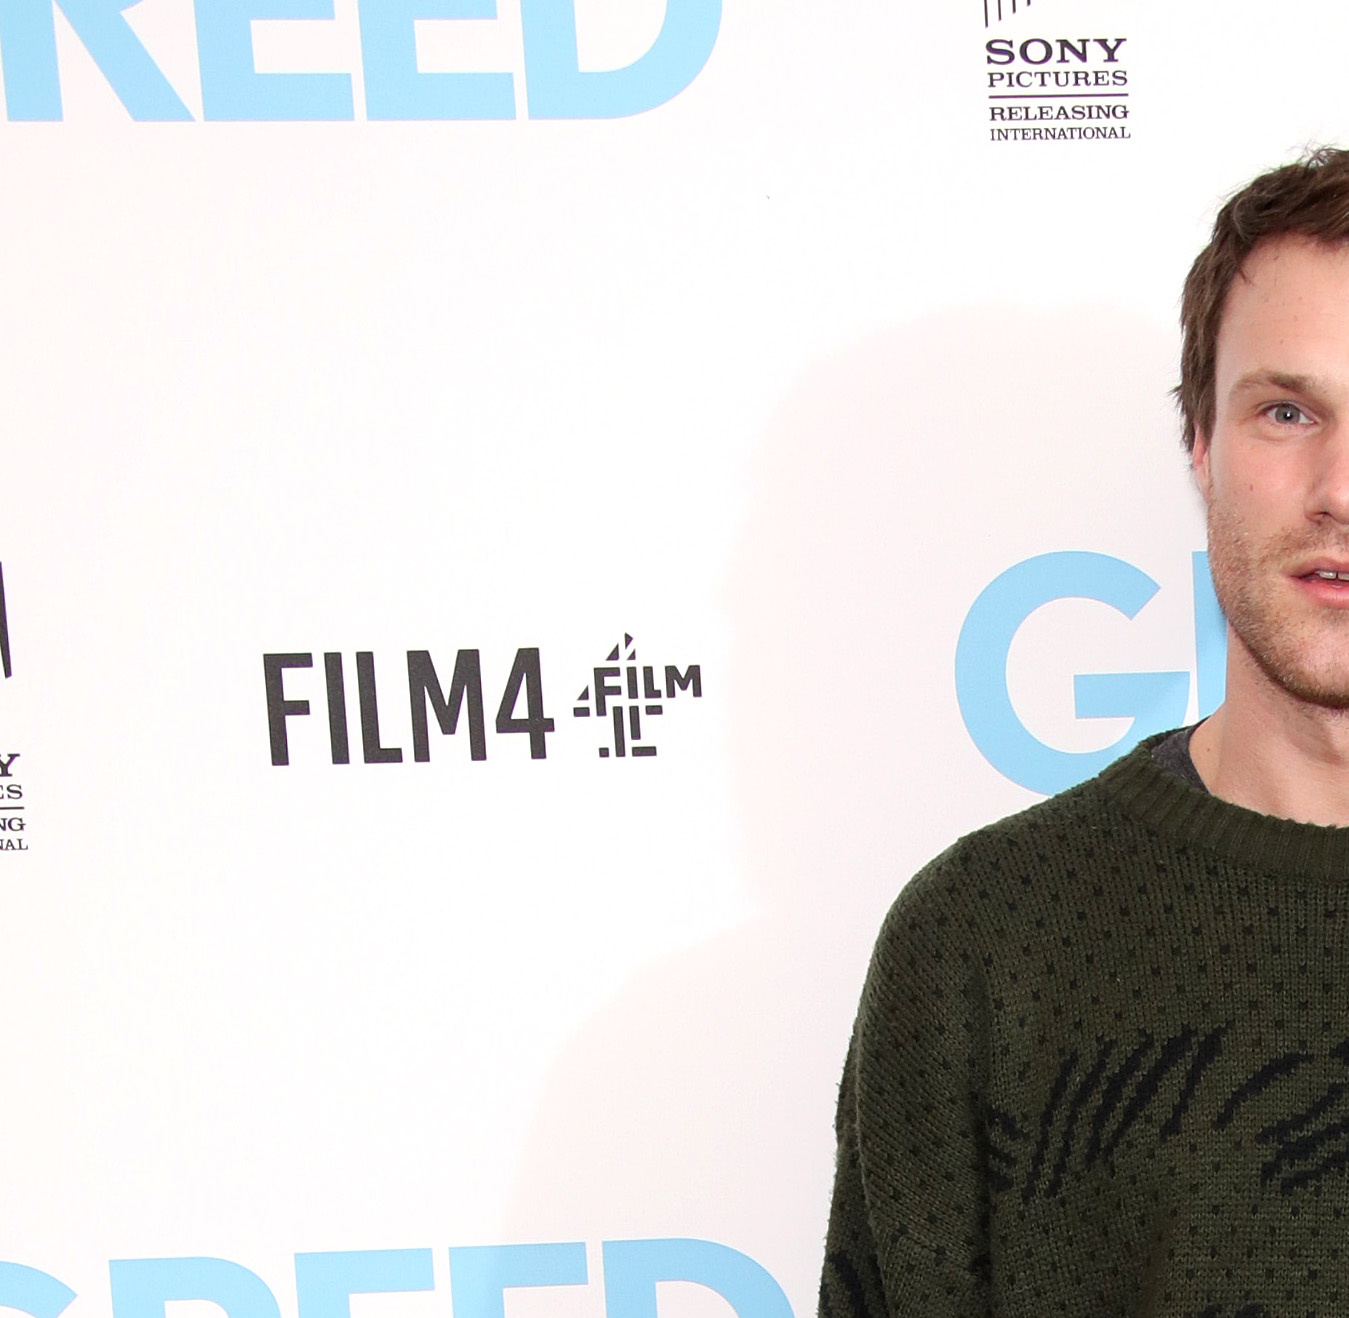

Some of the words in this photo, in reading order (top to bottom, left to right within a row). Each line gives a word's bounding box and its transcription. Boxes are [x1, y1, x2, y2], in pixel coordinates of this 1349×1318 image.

[985, 38, 1127, 66] SONY
[987, 70, 1128, 88] PICTURES
[989, 104, 1130, 121] RELEASING
[990, 126, 1131, 141] INTERNATIONAL
[262, 647, 555, 766] FILM4
